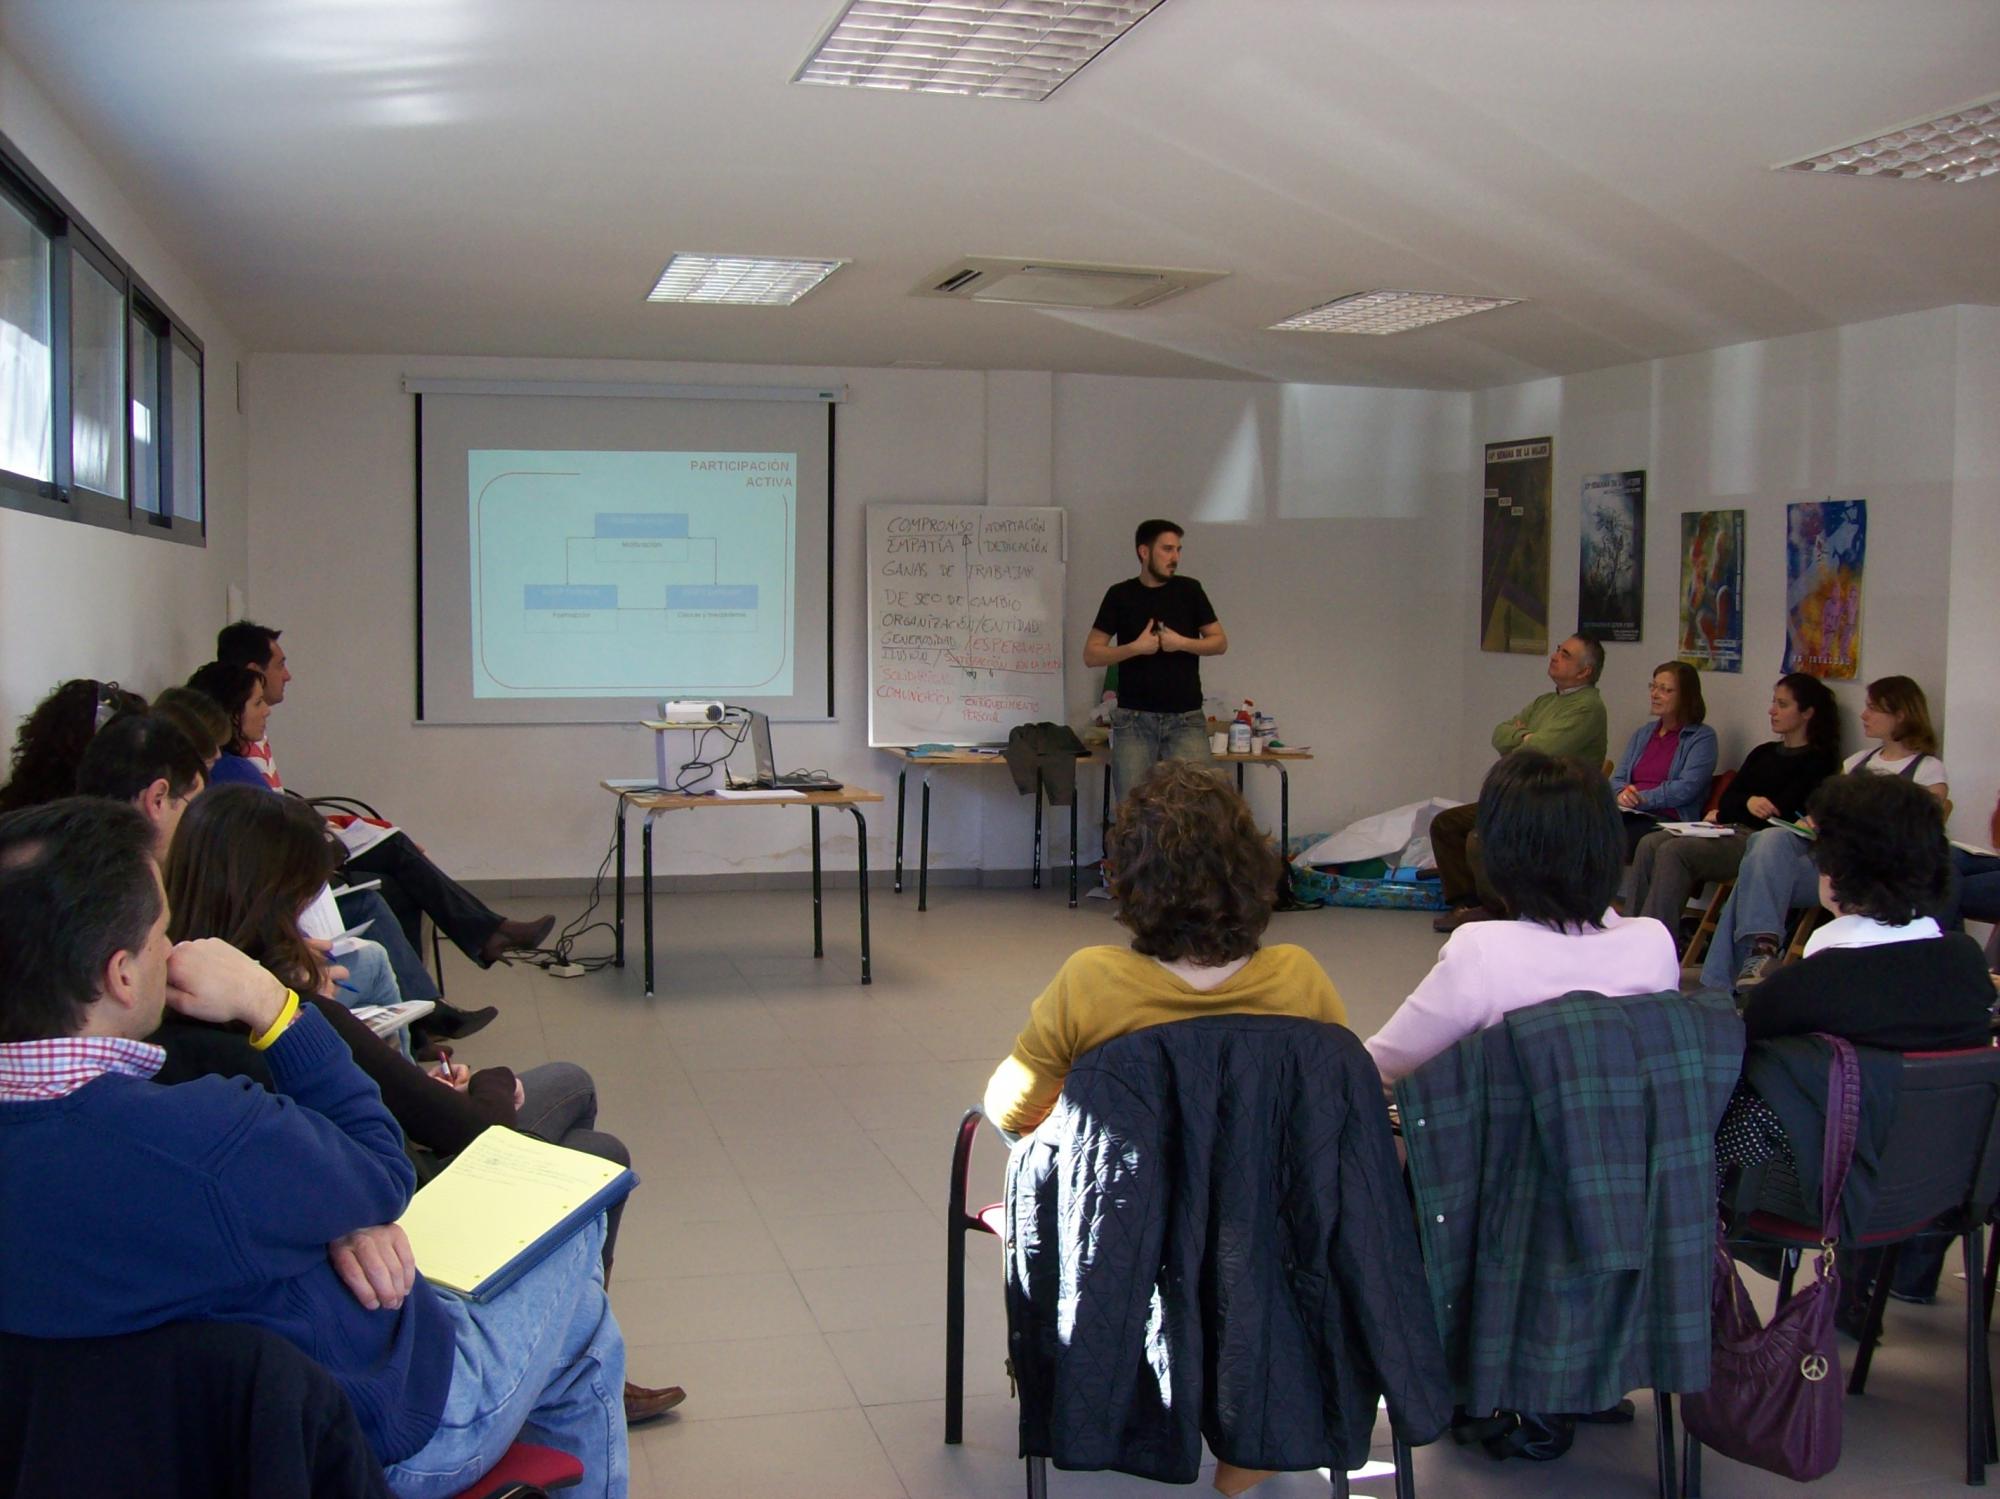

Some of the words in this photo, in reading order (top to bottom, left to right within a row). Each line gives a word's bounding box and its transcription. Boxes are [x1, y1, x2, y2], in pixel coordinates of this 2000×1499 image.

[690, 459, 789, 471] PARTICIPACIÓN
[746, 477, 793, 487] ACTIVA
[887, 536, 954, 553] EMPATÍA
[882, 561, 928, 578] GANAS
[941, 564, 955, 578] DE
